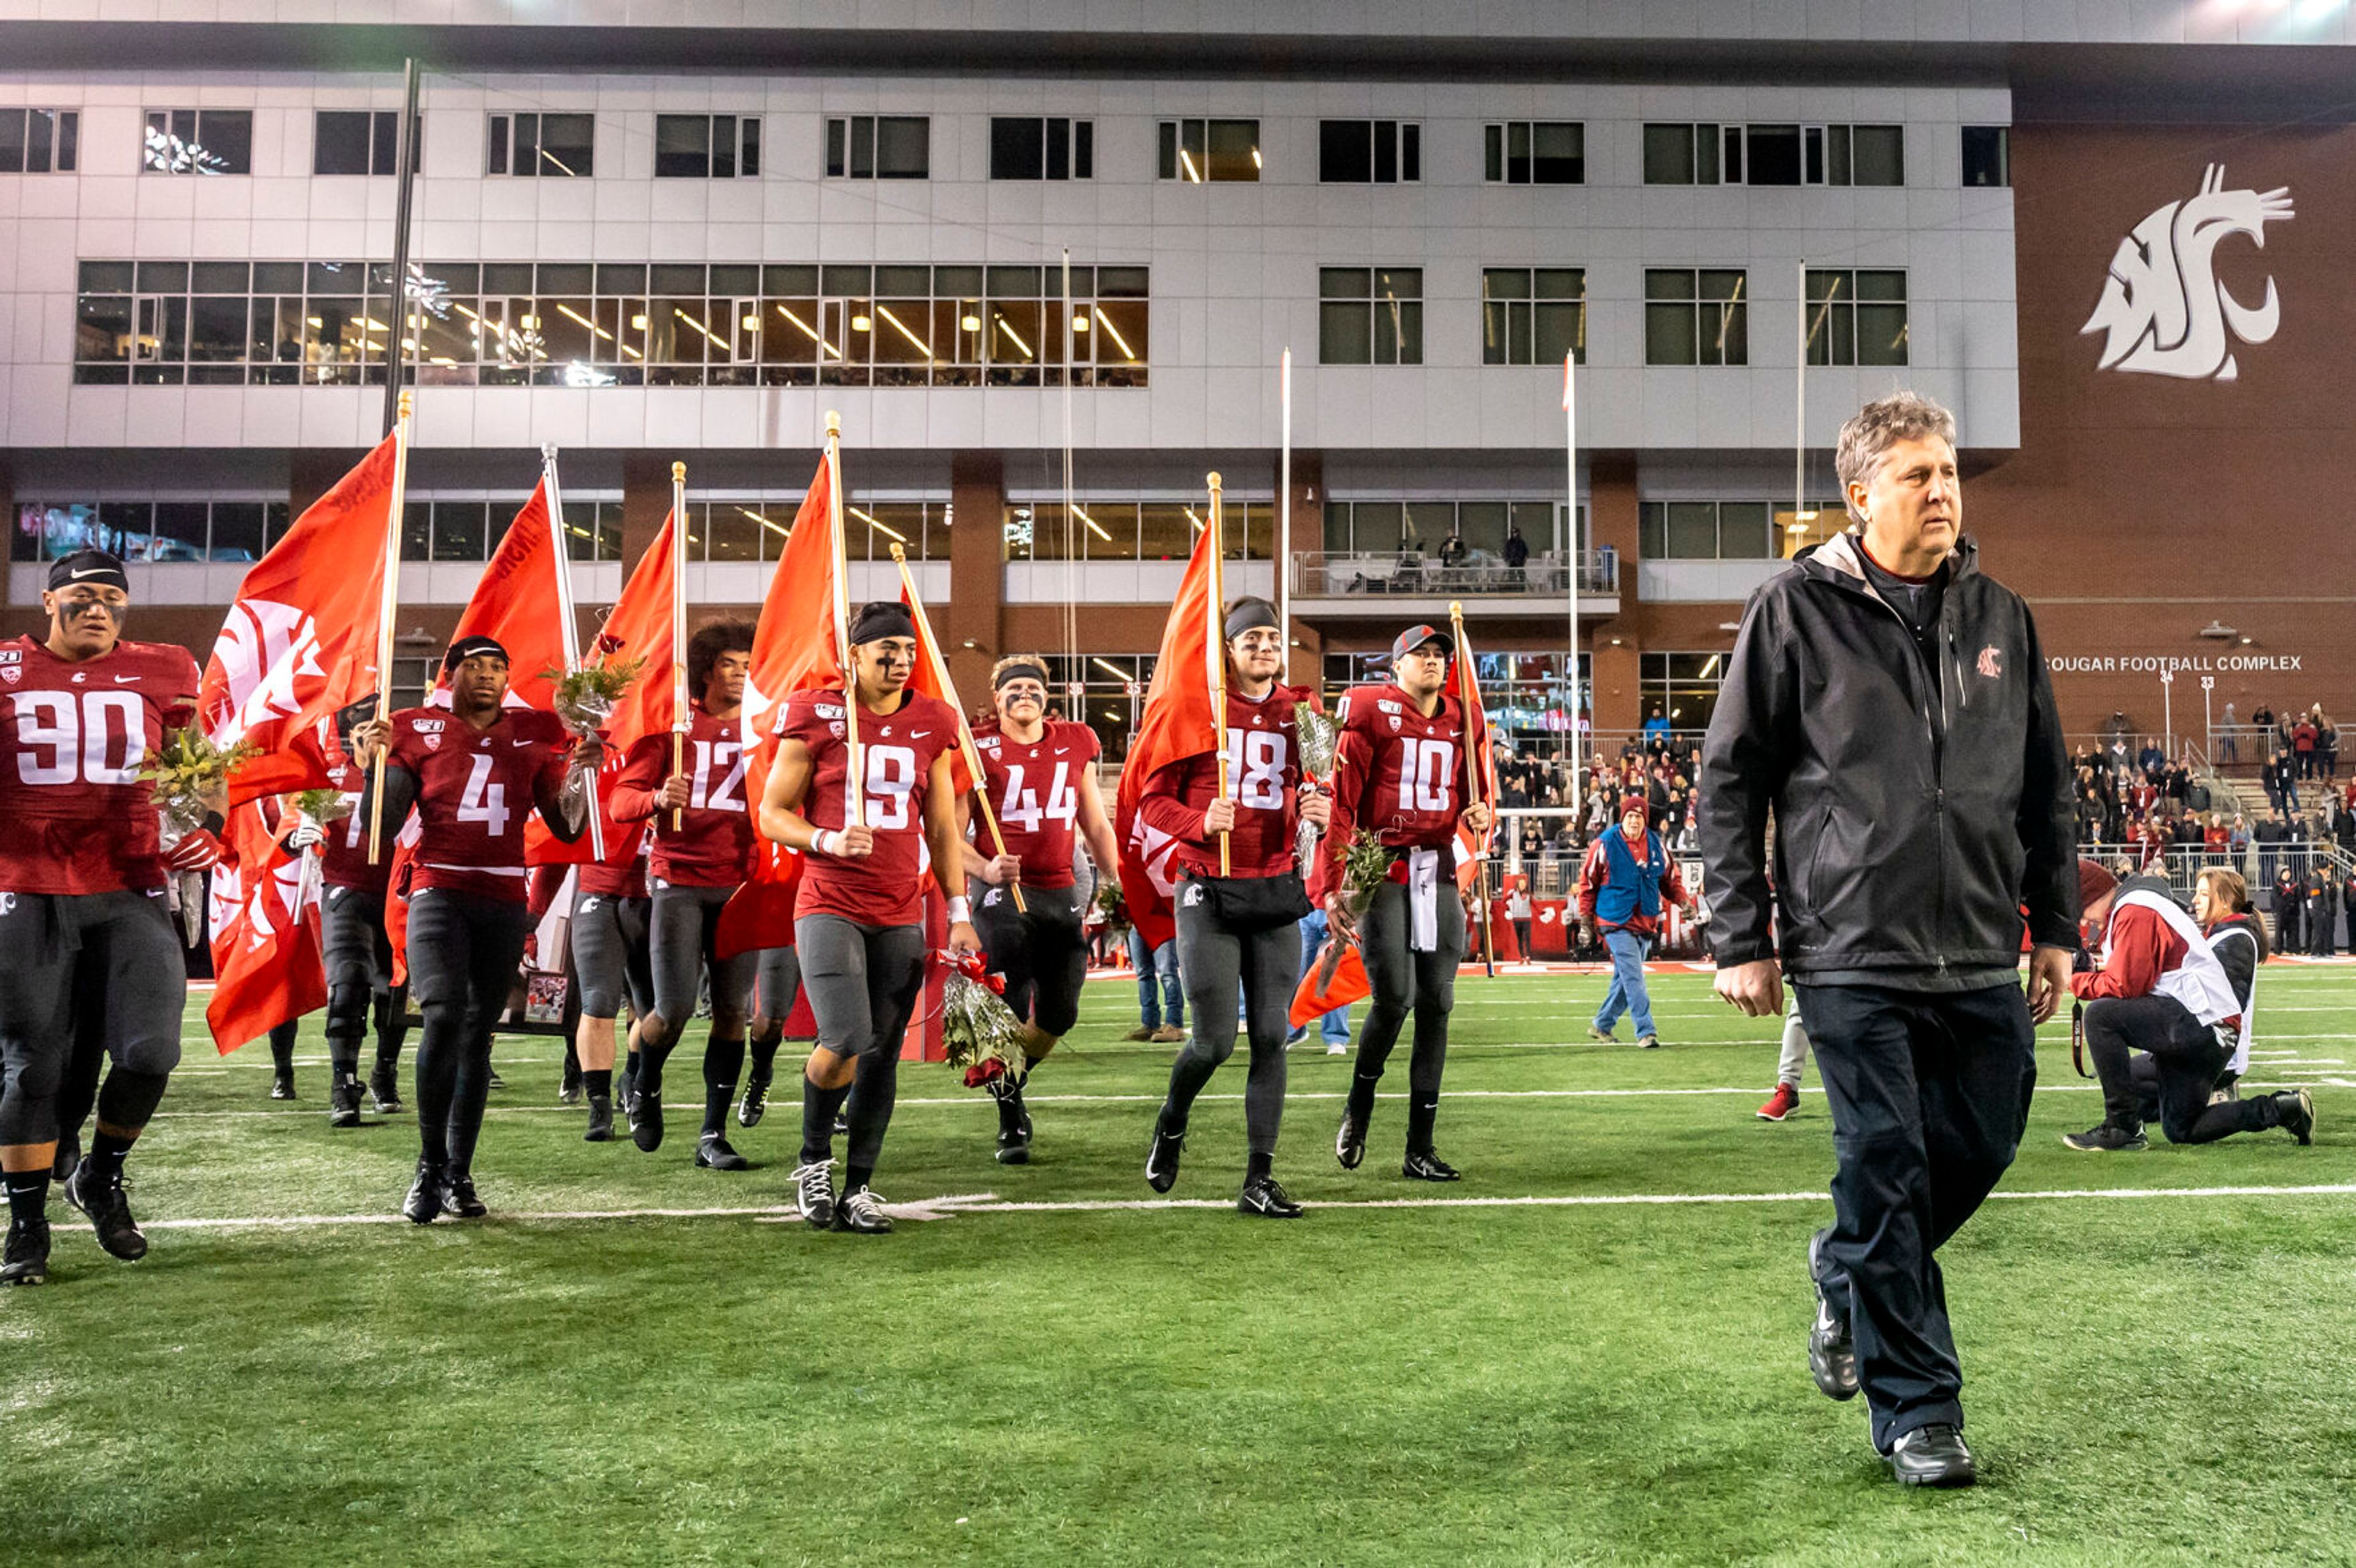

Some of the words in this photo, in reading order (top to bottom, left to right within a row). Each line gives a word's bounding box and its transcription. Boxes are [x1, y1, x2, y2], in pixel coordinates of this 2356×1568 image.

[1126, 682, 1141, 694] 35
[2120, 656, 2212, 671] FOOTBALL
[2217, 656, 2302, 671] COMPLEX
[2200, 677, 2215, 689] 33
[7, 690, 147, 785] 90
[1226, 728, 1287, 810] 18
[1399, 737, 1454, 811] 10
[456, 753, 510, 836] 4
[690, 740, 745, 812] 12
[844, 741, 915, 830] 19
[1001, 761, 1078, 832] 44
